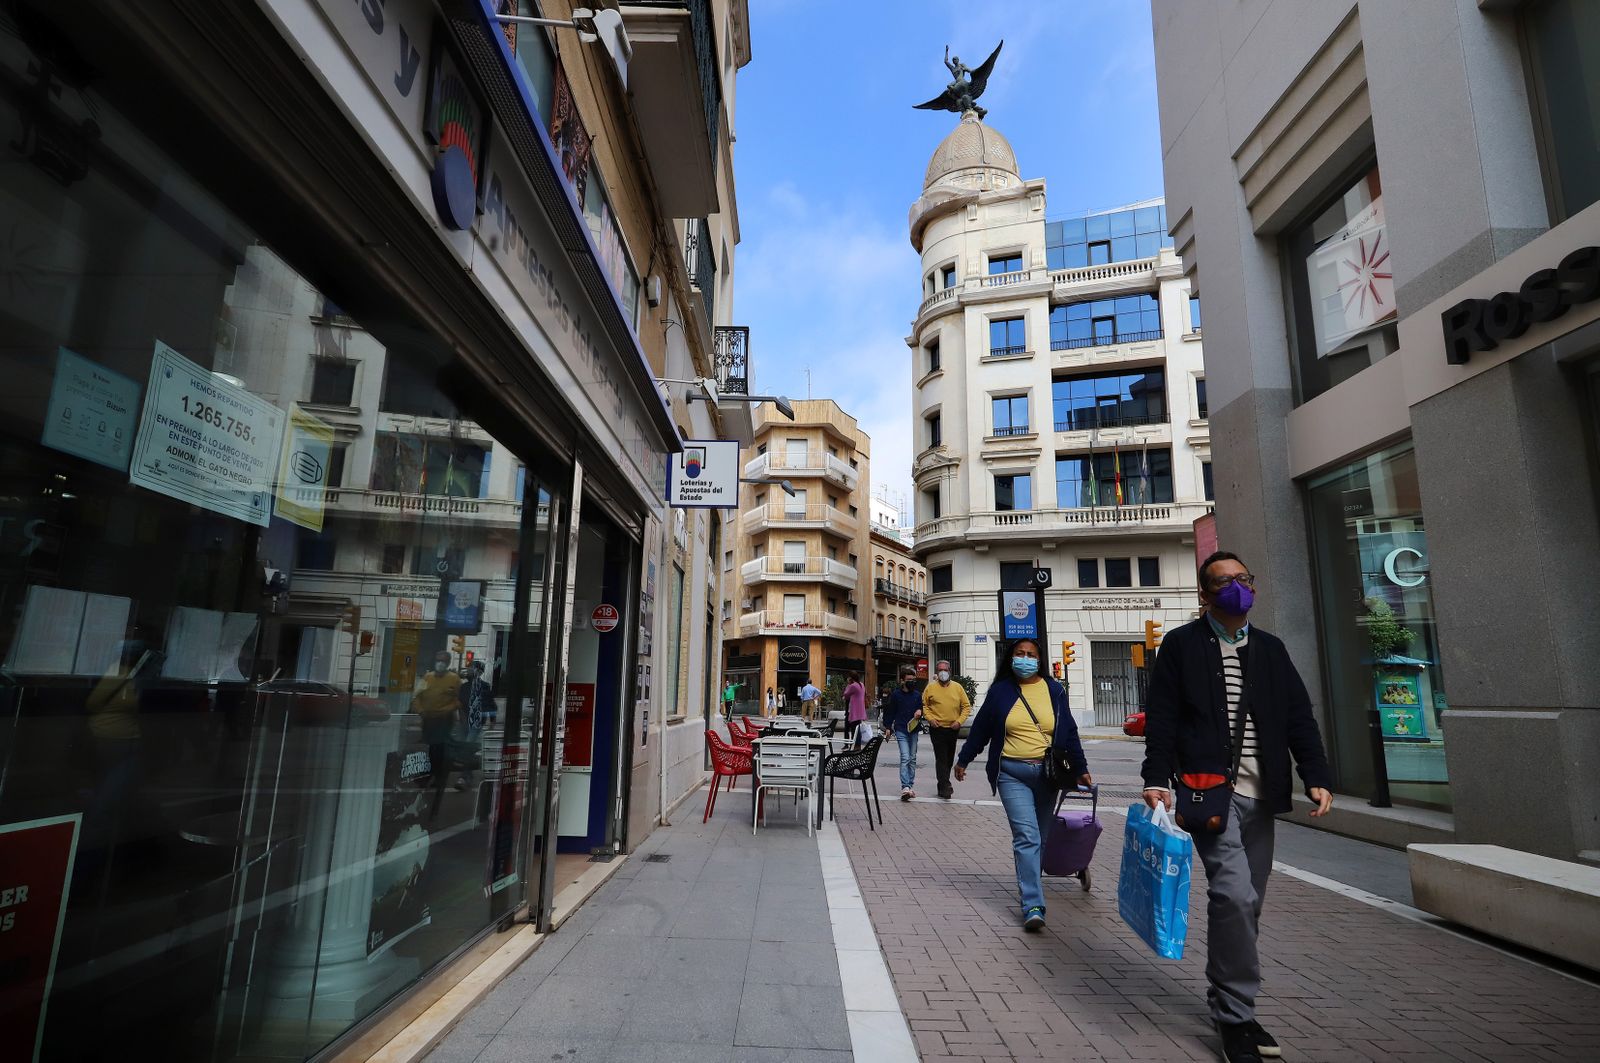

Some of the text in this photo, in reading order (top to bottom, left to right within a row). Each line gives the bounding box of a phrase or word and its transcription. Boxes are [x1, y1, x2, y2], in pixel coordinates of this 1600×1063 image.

[395, 23, 420, 97] y
[484, 171, 569, 333] Apuestas
[106, 400, 127, 415] Bizum
[190, 378, 254, 417] HEMOS REPARTIDO
[156, 414, 168, 426] EN
[169, 419, 202, 440] PREMIOS
[202, 434, 208, 443] A
[208, 436, 219, 449] LO
[219, 439, 241, 458] LARGO
[241, 449, 250, 461] DE
[169, 430, 252, 473] EN ESTE PUNTO DE VENTA
[198, 457, 207, 468] EL
[209, 462, 229, 477] GATO
[229, 468, 253, 486] NEGRO
[597, 607, 613, 616] +18
